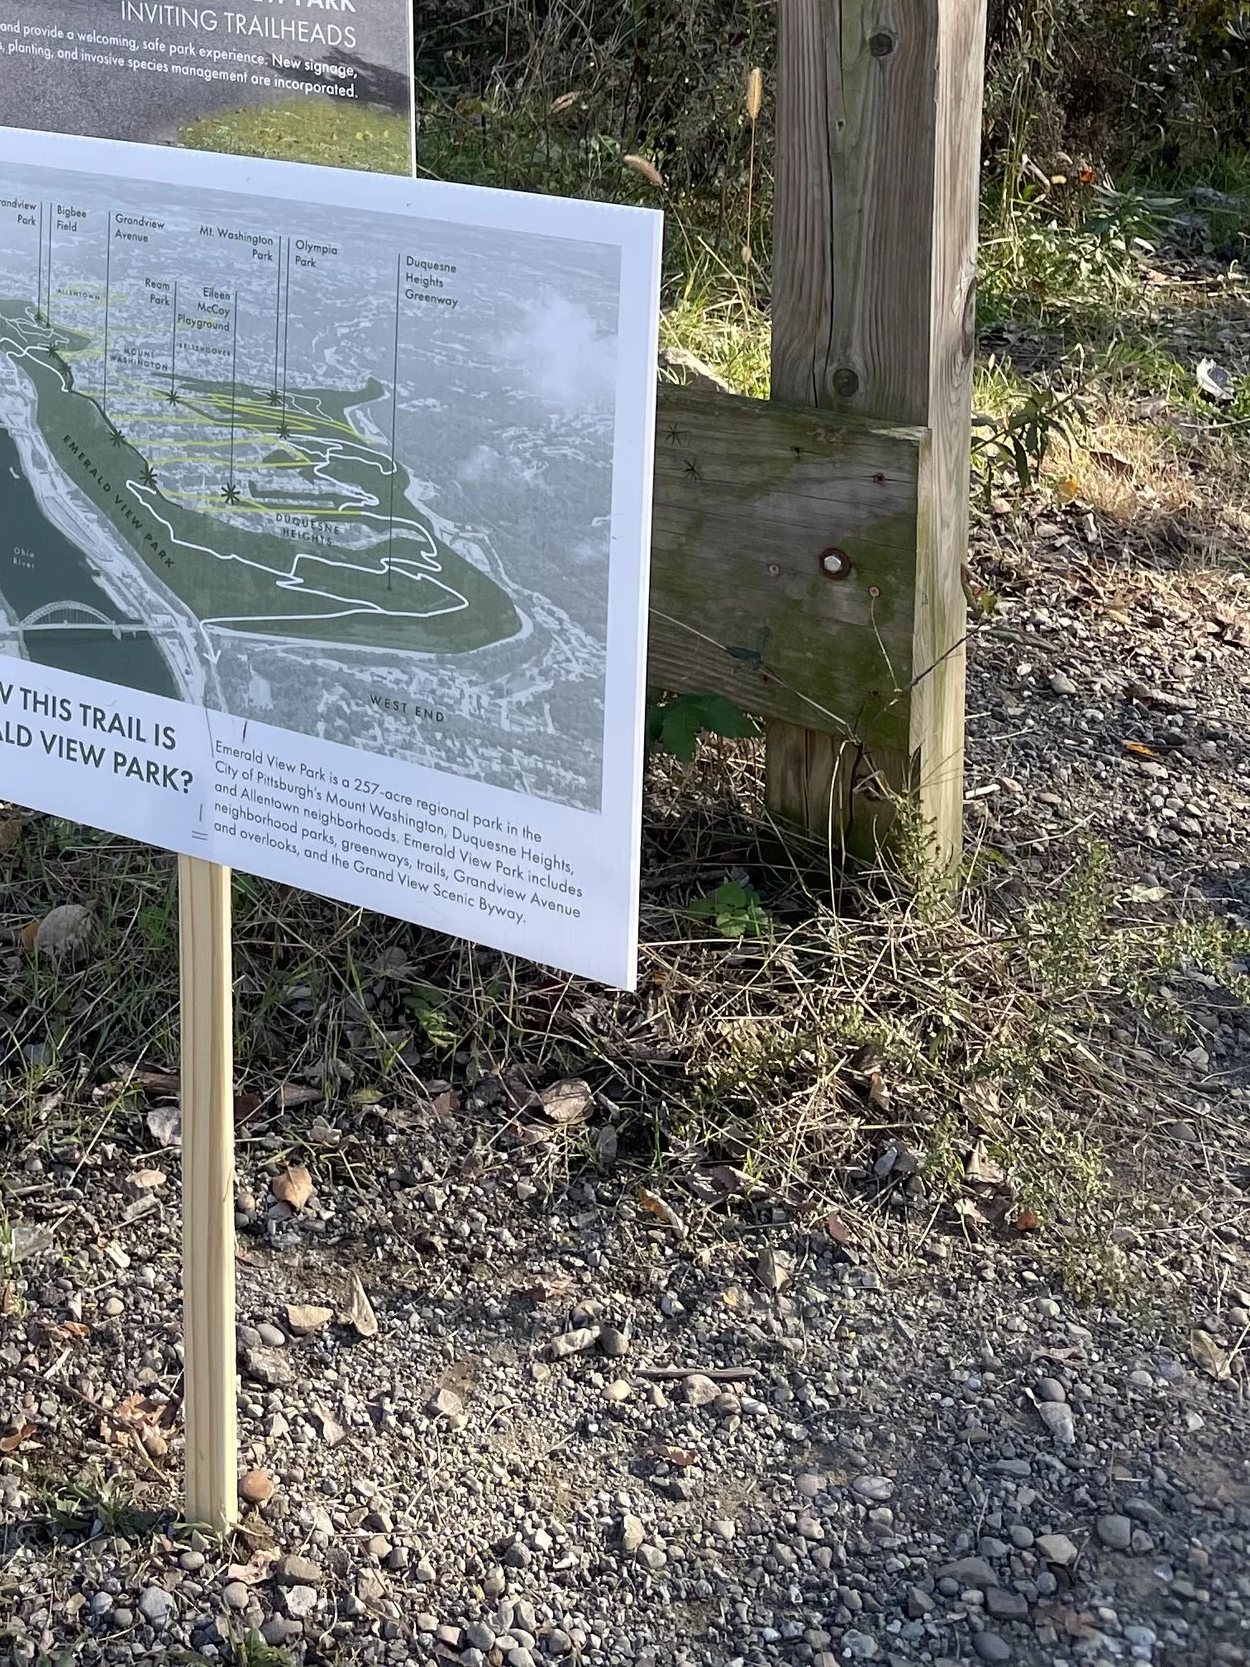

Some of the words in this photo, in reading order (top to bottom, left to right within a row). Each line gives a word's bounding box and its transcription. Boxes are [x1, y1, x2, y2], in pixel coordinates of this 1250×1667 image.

[121, 0, 218, 31] INVITING
[223, 11, 356, 48] TRAILHEADS
[0, 19, 20, 33] and
[22, 24, 64, 39] provide
[66, 31, 74, 40] a
[76, 29, 139, 52] welcoming,
[142, 37, 166, 52] safe
[168, 41, 196, 56] park
[198, 47, 268, 65] experience.
[271, 52, 301, 69] New
[304, 57, 357, 79] signage,
[7, 38, 54, 60] planting,
[56, 46, 78, 60] and
[80, 48, 125, 67] invasive
[127, 58, 168, 72] species
[171, 64, 248, 83] management
[250, 74, 271, 86] are
[273, 73, 358, 98] incorporated.
[17, 214, 36, 226] Park
[56, 205, 87, 219] Bigbee
[56, 221, 77, 232] Field
[115, 214, 165, 230] Grandview
[114, 229, 149, 243] Avenue
[200, 226, 214, 237] Mt.
[217, 228, 274, 246] Washington
[252, 249, 273, 262] Park
[295, 239, 338, 256] Olympia
[295, 256, 316, 268] Park
[406, 255, 457, 274] Duquesne
[145, 278, 170, 291] Ream
[405, 273, 444, 289] Heights
[150, 294, 170, 307] Park
[203, 287, 231, 301] Eileen
[405, 289, 458, 309] Greenway
[197, 302, 231, 318] McCoy
[177, 314, 230, 332] Playground
[62, 434, 111, 493] EMERALD
[114, 494, 143, 531] VIEW
[144, 533, 175, 569] PARK
[276, 513, 340, 535] DUQUESNE
[282, 528, 333, 547] HEIGHTS
[369, 694, 408, 713] WEST
[415, 706, 445, 722] END
[19, 686, 72, 722] THIS
[78, 702, 146, 743] TRAIL
[154, 722, 176, 750] IS
[39, 729, 106, 768] VIEW
[113, 750, 193, 794] PARK?
[215, 739, 263, 764] Emerald
[266, 753, 296, 773] View
[299, 762, 325, 782] Park
[329, 775, 338, 785] is
[341, 778, 350, 788] a
[354, 777, 412, 806] 257-acre
[416, 799, 469, 822] regional
[472, 815, 502, 832] park
[506, 822, 518, 835] in
[522, 825, 541, 843] the
[214, 760, 238, 780] City
[241, 768, 253, 781] of
[325, 790, 366, 813] Mount
[368, 801, 447, 837] Washington,
[452, 825, 516, 856] Duquesne
[521, 846, 574, 875] Heights,
[214, 783, 237, 797] and
[239, 787, 299, 814] Allentown
[303, 808, 396, 842] neighborhoods.
[403, 832, 455, 859] Emerald
[459, 848, 492, 870] View
[495, 859, 524, 880] Park
[527, 869, 582, 897] includes
[214, 802, 297, 834] neighborhood
[301, 827, 337, 847] parks,
[341, 839, 412, 869] greenways,
[416, 858, 448, 880] trails,
[453, 868, 526, 901] Grandview
[529, 891, 580, 918] Avenue
[213, 822, 236, 836] and
[239, 829, 300, 856] overlooks,
[303, 848, 328, 863] and
[331, 852, 349, 869] the
[352, 859, 394, 882] Grand
[397, 871, 429, 892] View
[432, 882, 474, 907] Scenic
[479, 896, 526, 925] Byway.
